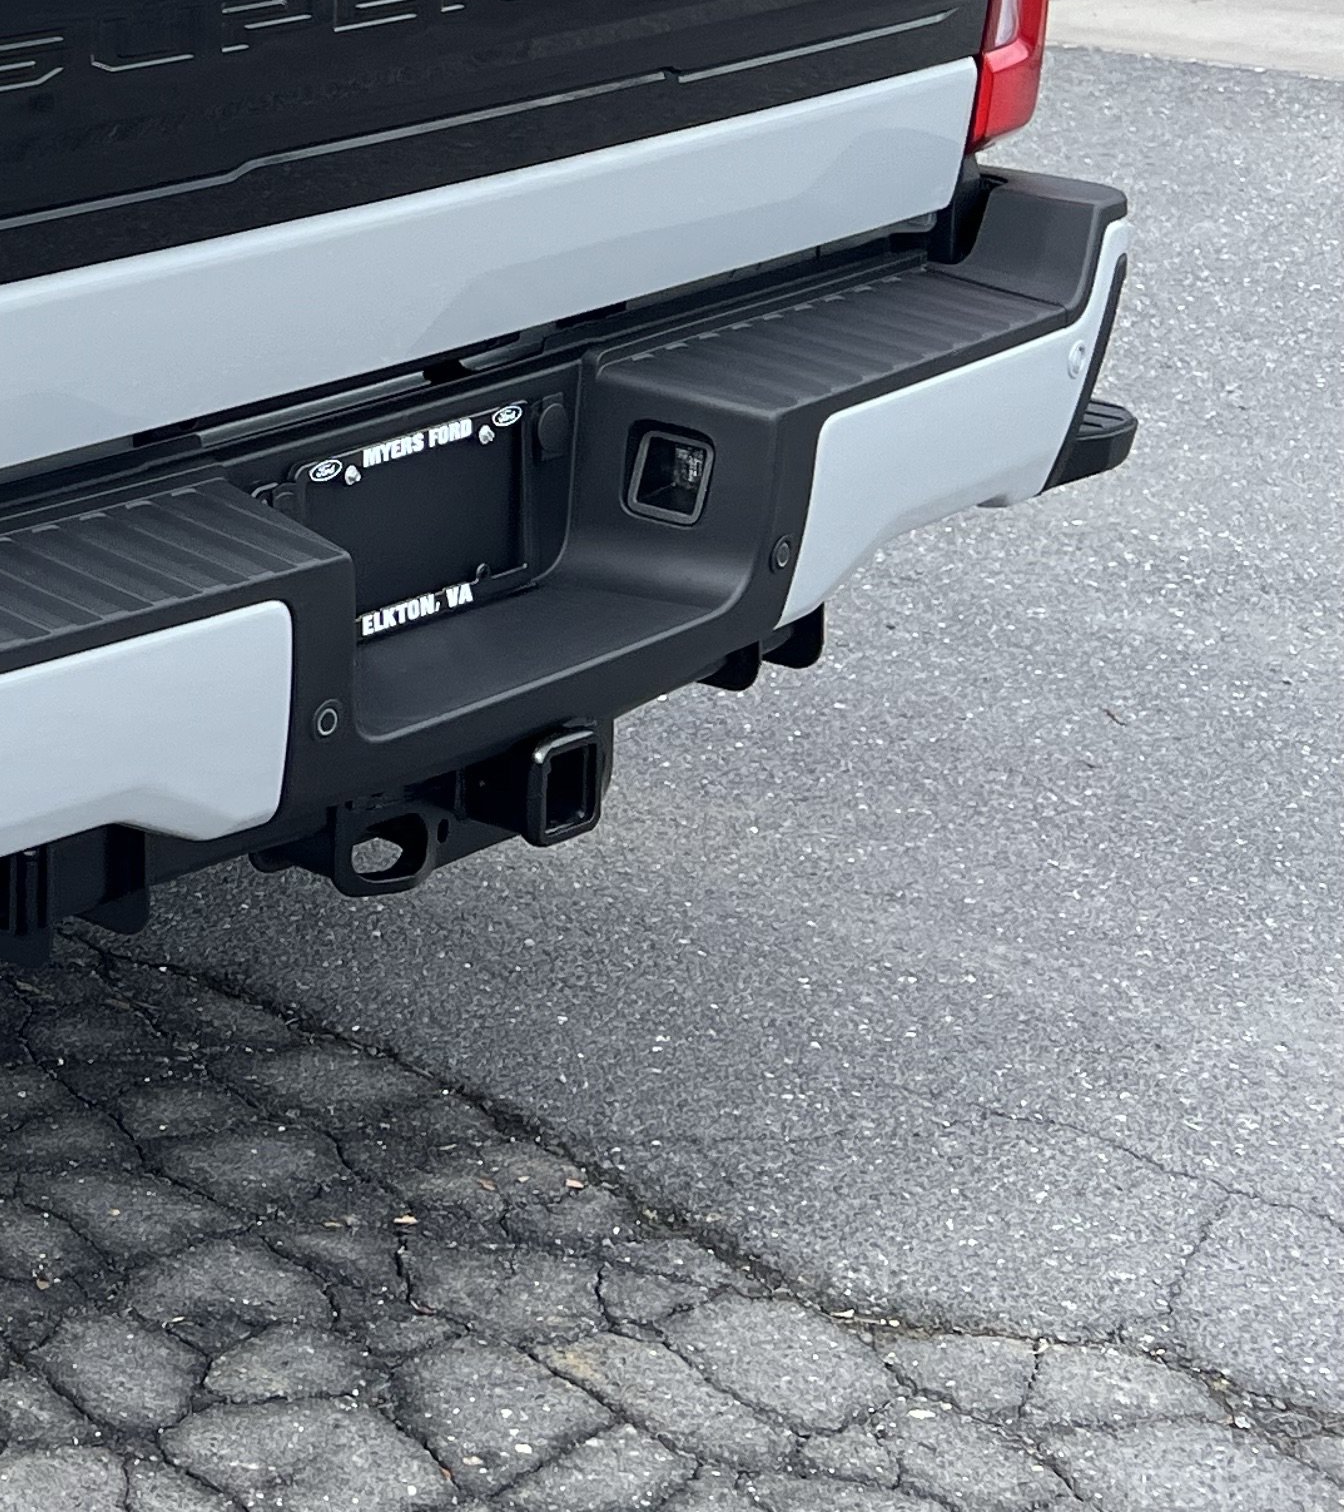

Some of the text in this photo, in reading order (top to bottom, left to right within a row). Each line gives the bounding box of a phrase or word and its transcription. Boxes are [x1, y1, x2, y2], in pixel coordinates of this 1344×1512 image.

[362, 431, 425, 469] MYERS
[428, 417, 473, 449] FORD
[361, 582, 474, 637] ELKTON, VA
